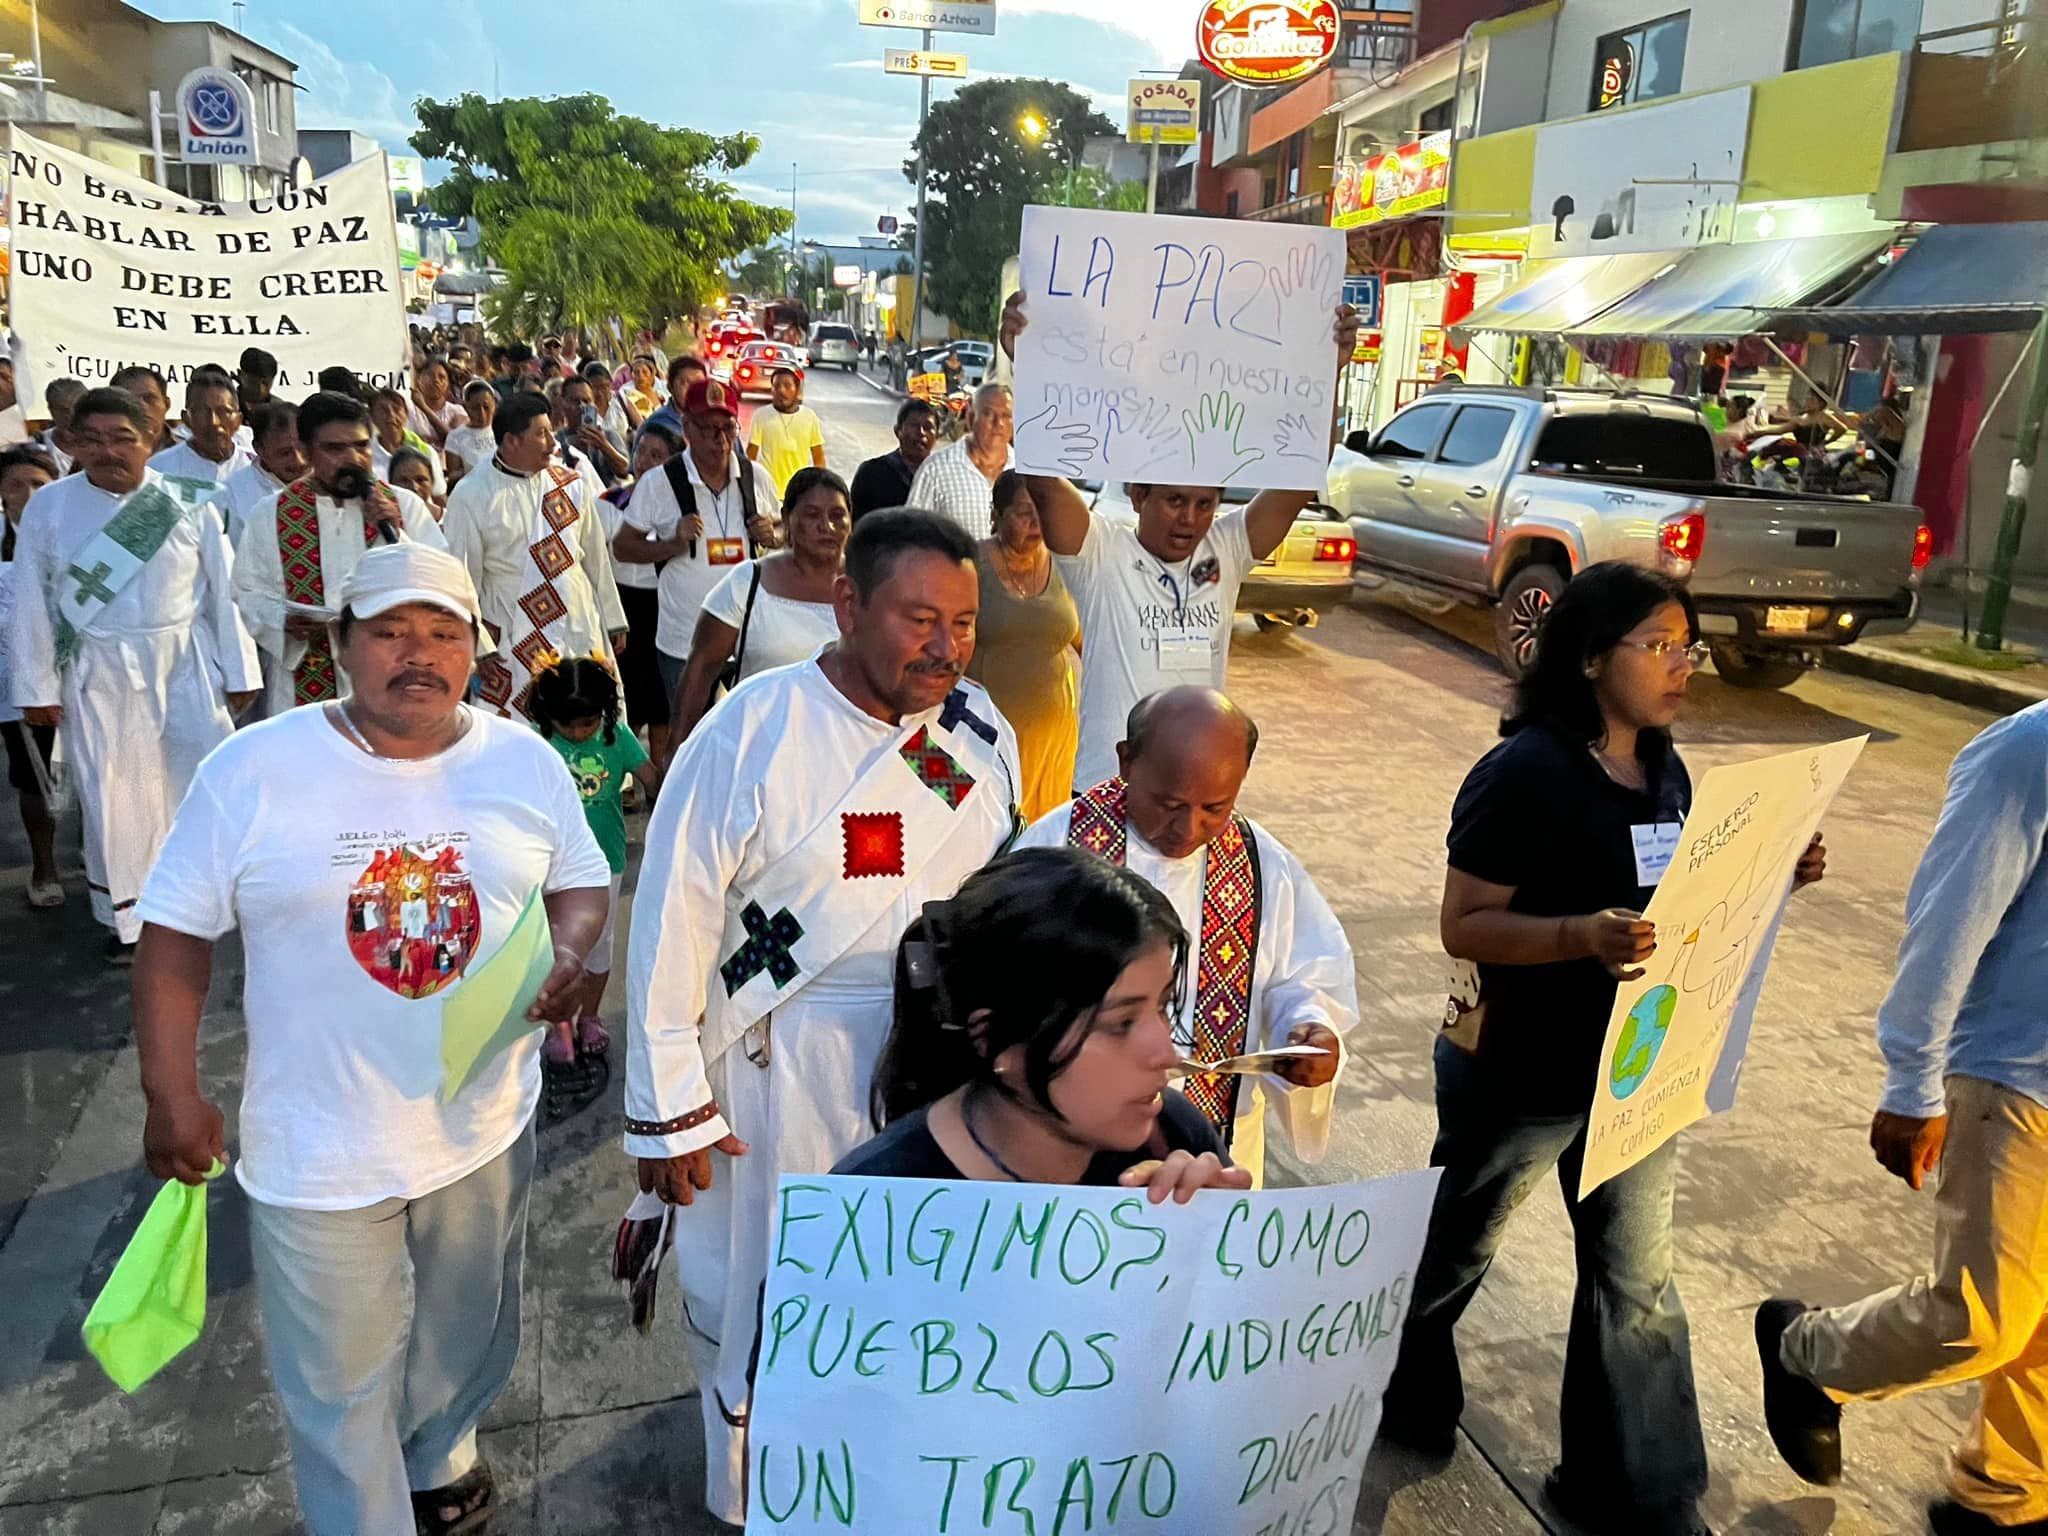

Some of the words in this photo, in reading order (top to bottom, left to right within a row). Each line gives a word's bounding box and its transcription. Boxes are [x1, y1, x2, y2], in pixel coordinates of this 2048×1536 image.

[899, 10, 937, 24] Banco
[939, 12, 980, 25] Azteca
[1133, 83, 1195, 109] POSADA
[11, 151, 62, 186] NO
[18, 201, 196, 251] HABLAR
[216, 231, 271, 254] DE
[292, 216, 369, 248] PAZ
[16, 250, 92, 282] UNO
[121, 266, 231, 299] DEBE
[259, 269, 388, 299] CREER
[1047, 234, 1114, 308] LA
[1153, 243, 1282, 346] PAZ
[113, 306, 168, 331] EN
[191, 314, 310, 336] ELLA.
[1040, 325, 1147, 374] está
[1160, 349, 1200, 385] en
[1043, 382, 1142, 425] manos
[1687, 811, 1752, 874] PERSONAL
[1689, 790, 1760, 857] ESFUERZO
[1590, 1121, 1606, 1148] LA
[1611, 1108, 1634, 1135] PAZ
[1640, 1065, 1701, 1117] COMIENZA
[776, 1184, 1170, 1293] EXIGIMOS,
[1216, 1198, 1370, 1281] COMO
[766, 1293, 1120, 1404] PUEBLOS
[1165, 1270, 1408, 1393] INDIGENAS
[759, 1438, 856, 1529] UN
[918, 1451, 1178, 1536] TRATO
